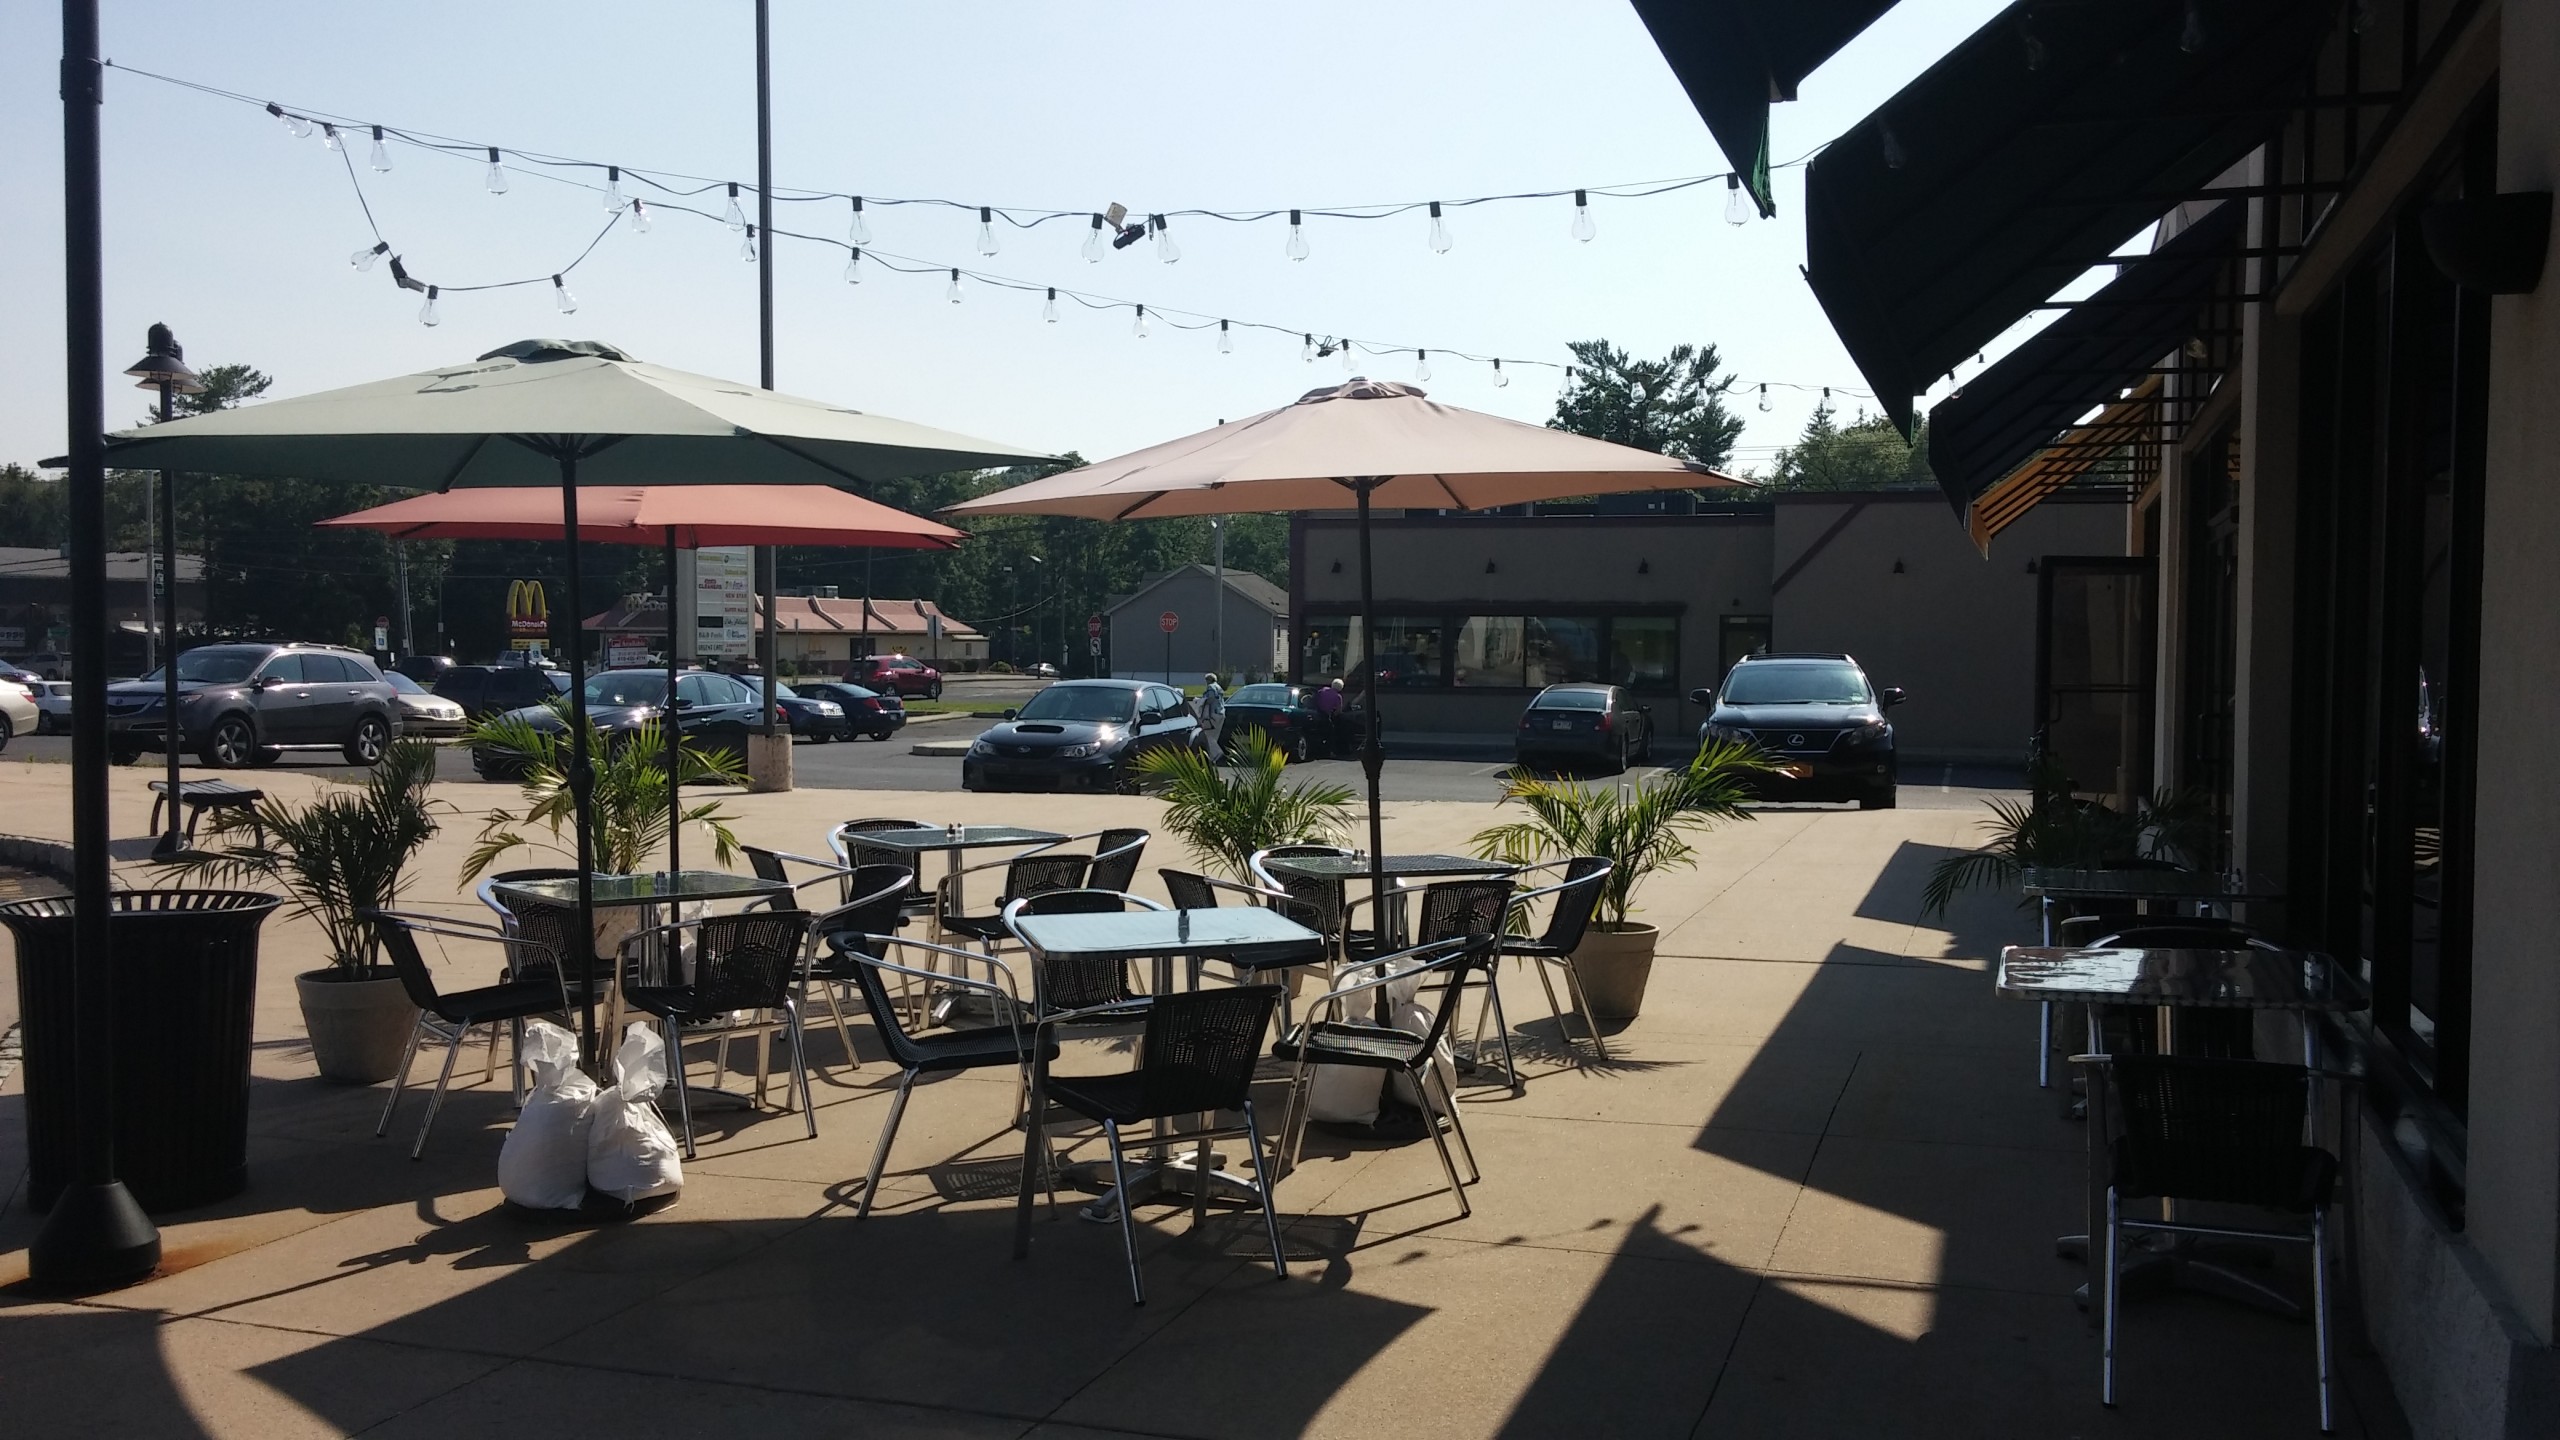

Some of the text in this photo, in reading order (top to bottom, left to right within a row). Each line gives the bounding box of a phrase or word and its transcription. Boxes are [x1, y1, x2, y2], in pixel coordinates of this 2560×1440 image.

[511, 620, 548, 628] McDonald's
[1161, 618, 1177, 626] STOP
[1089, 622, 1101, 632] STOP
